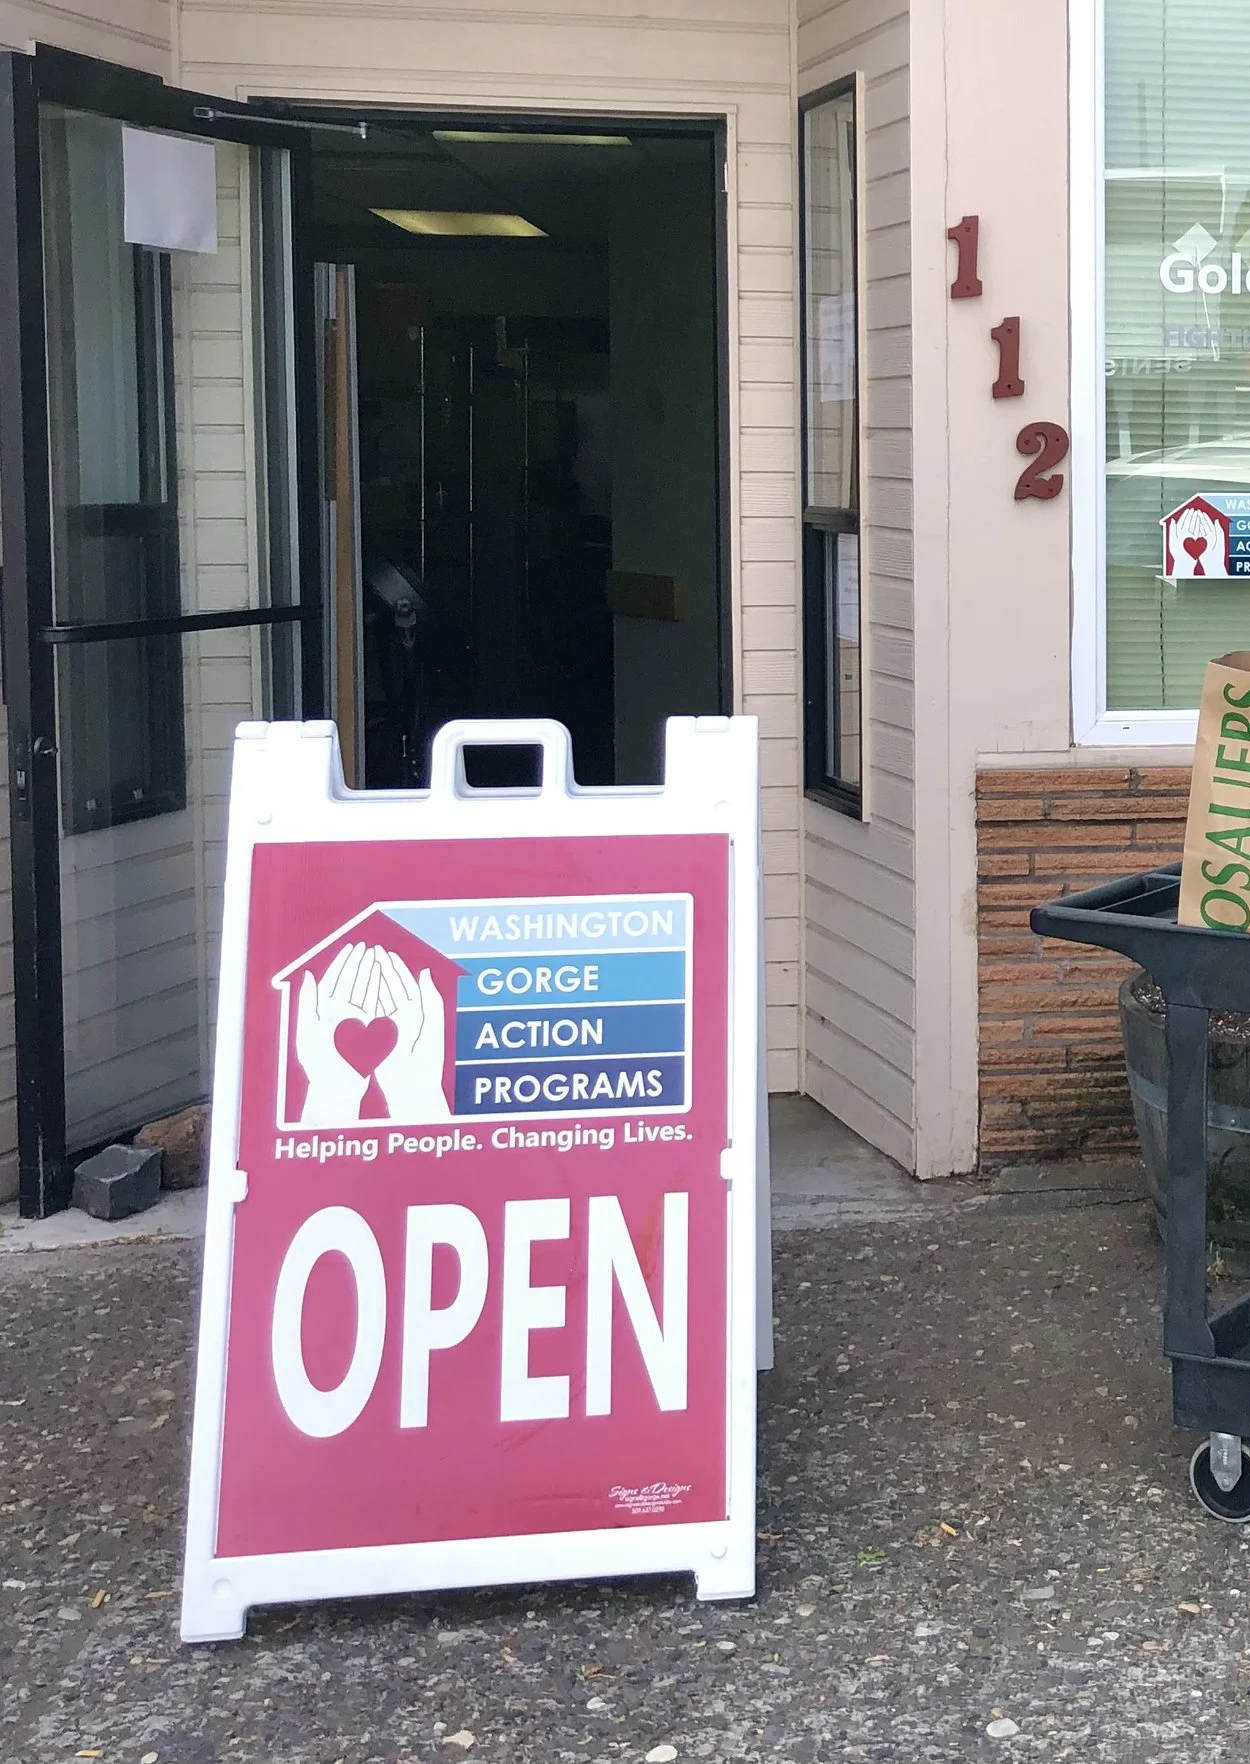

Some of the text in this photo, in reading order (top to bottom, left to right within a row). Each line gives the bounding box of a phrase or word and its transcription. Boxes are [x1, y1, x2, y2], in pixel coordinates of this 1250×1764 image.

[449, 909, 674, 942] WASHINGTON
[476, 965, 599, 995] GORGE
[474, 1018, 604, 1050] ACTION
[474, 1070, 663, 1104] PROGRAMS
[275, 1121, 693, 1163] Helping People. Changing Lives.
[272, 1192, 688, 1438] OPEN
[608, 1485, 639, 1501] Signs
[650, 1482, 692, 1497] Designs
